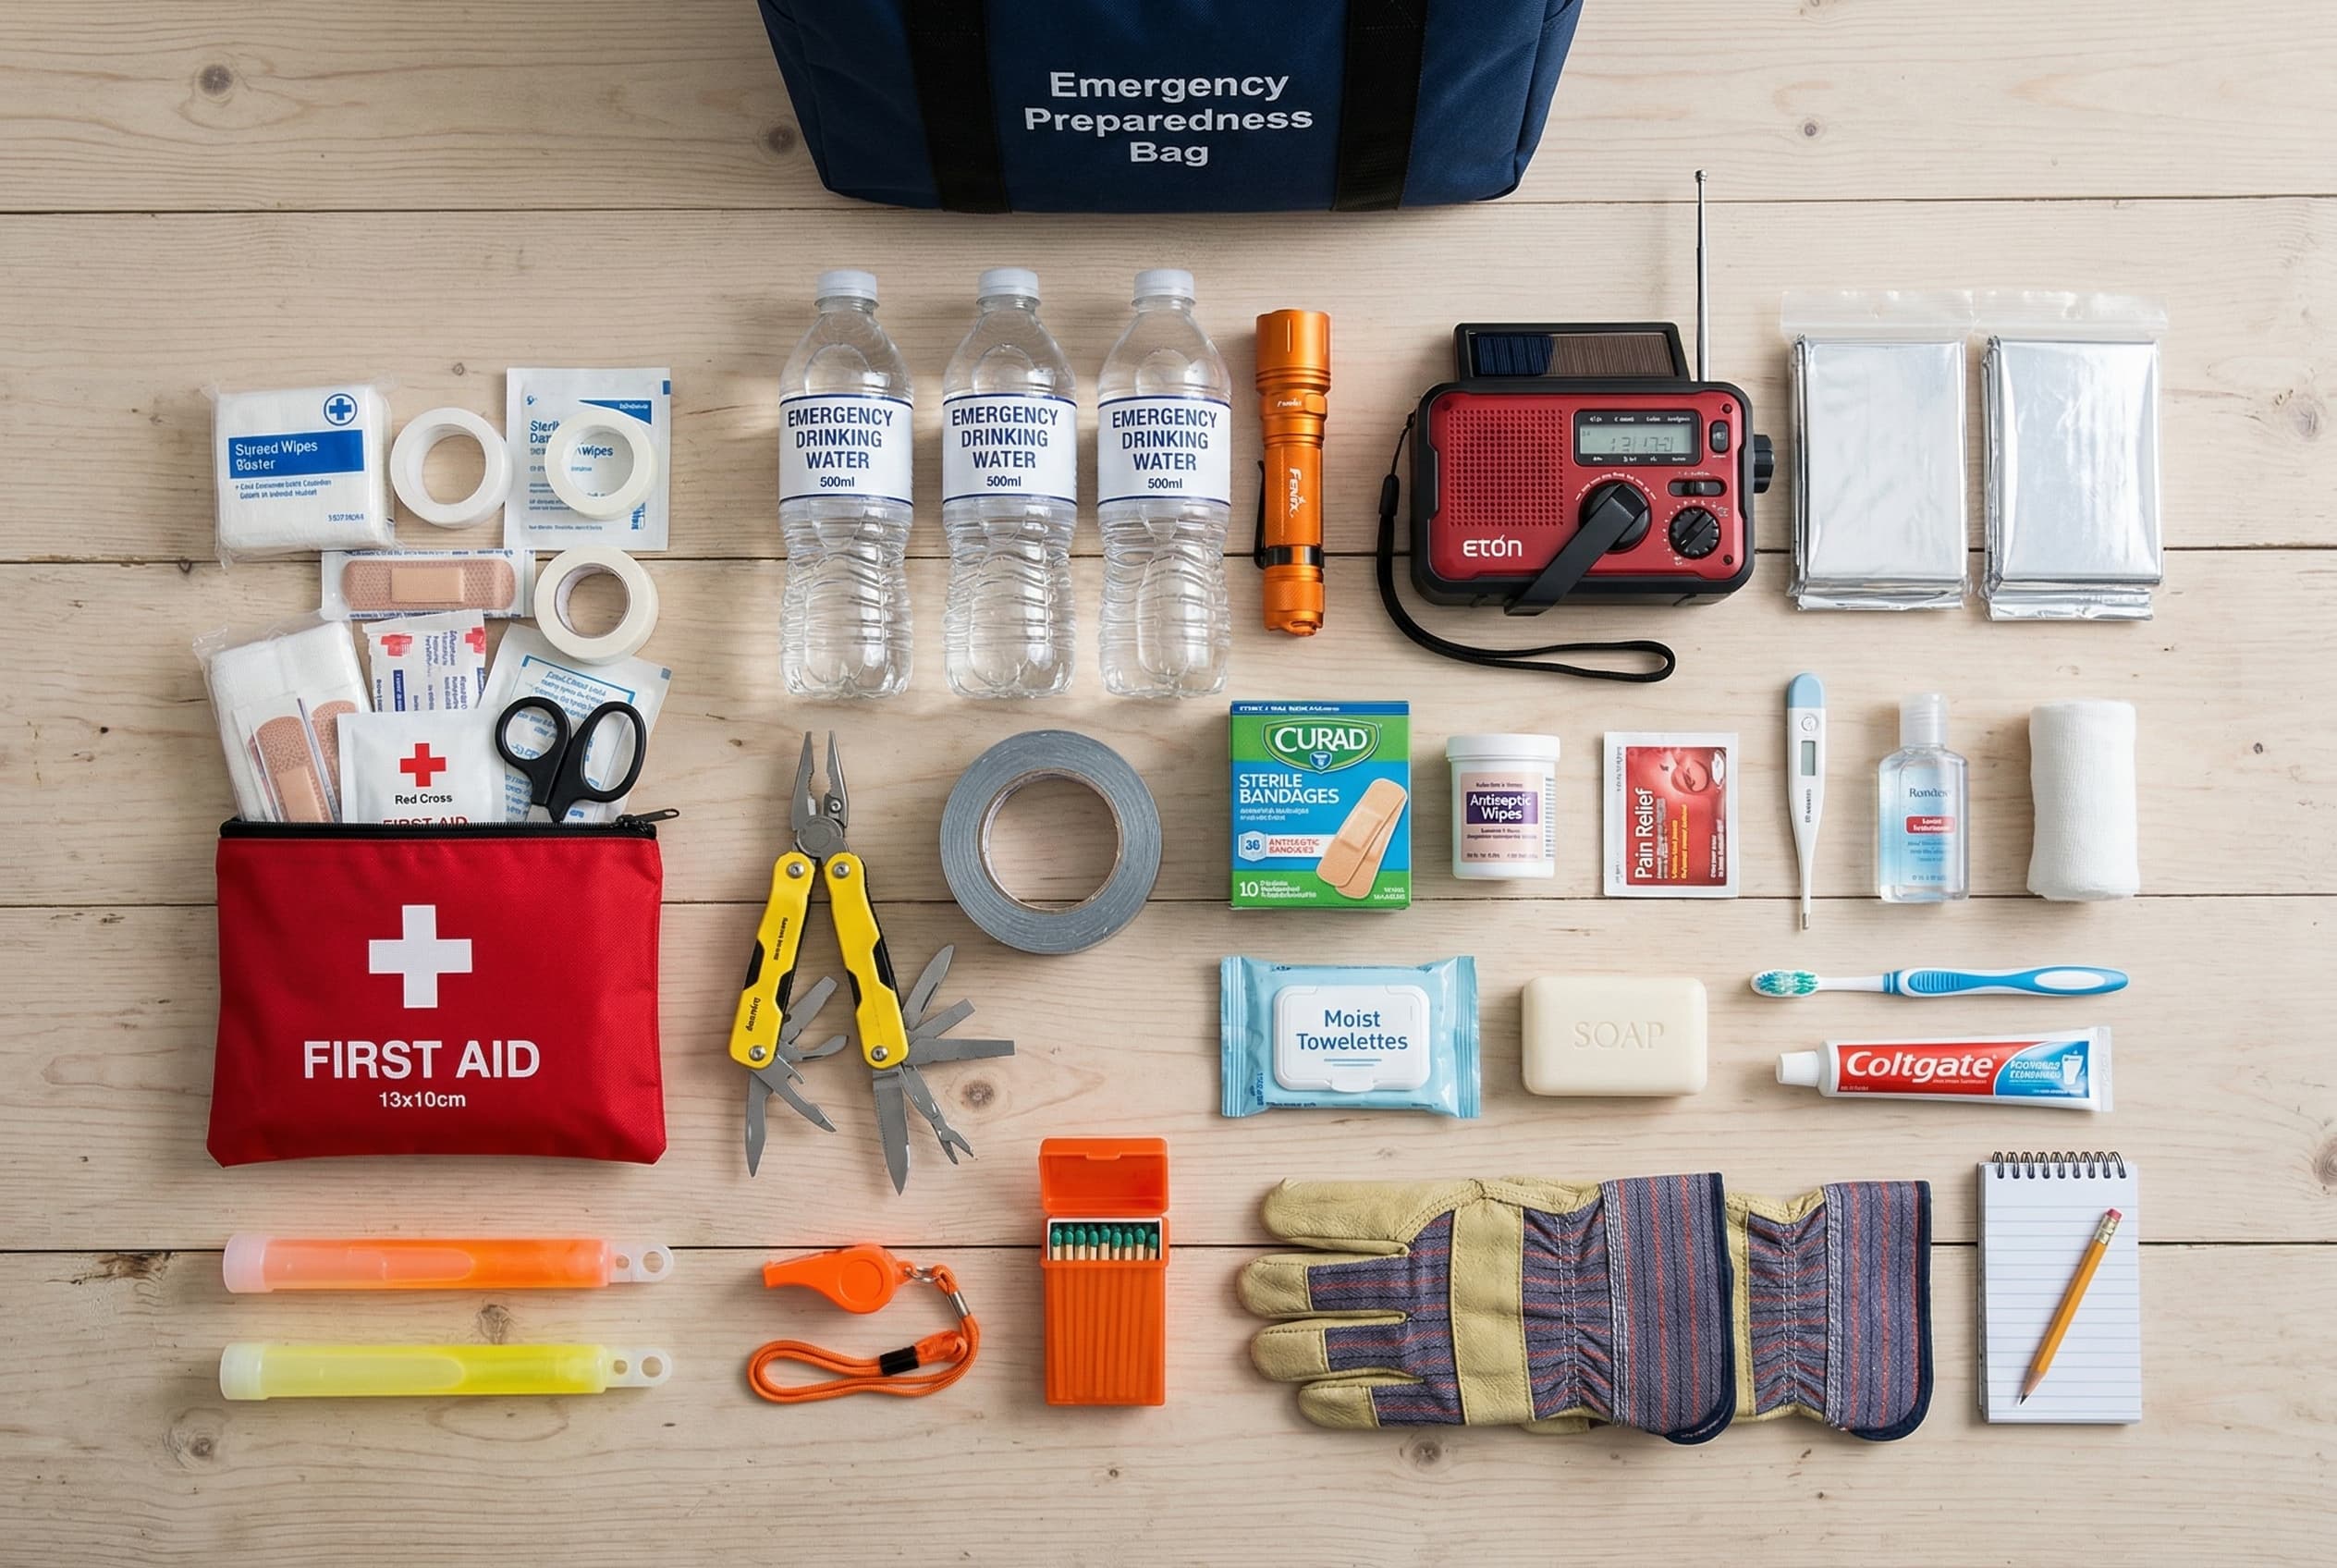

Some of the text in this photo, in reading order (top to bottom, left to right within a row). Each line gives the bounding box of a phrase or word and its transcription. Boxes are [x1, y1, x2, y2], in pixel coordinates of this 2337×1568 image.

[1050, 71, 1290, 104] Emergency
[1024, 107, 1314, 137] Preparedness
[1130, 141, 1209, 166] Bag
[788, 406, 894, 427] EMERGENCY
[952, 406, 1058, 426] EMERGENCY
[1112, 408, 1217, 429] EMERGENCY
[796, 428, 883, 448] DRINKING
[961, 428, 1048, 448] DRINKING
[1122, 430, 1208, 450] DRINKING
[281, 440, 318, 456] Wipes
[581, 445, 614, 459] Wipes
[806, 451, 870, 469] WATER
[973, 450, 1036, 469] WATER
[1132, 453, 1196, 471] WATER
[820, 476, 855, 488] 500ml
[986, 475, 1022, 487] 500ml
[1147, 478, 1183, 489] 500ml
[1275, 727, 1368, 753] CURAD
[1239, 774, 1303, 788] STERILE
[395, 793, 453, 804] Red Cross
[1240, 789, 1340, 804] BANDAGES
[1470, 794, 1531, 809] Antiseptic
[1481, 806, 1523, 823] Wipes
[1634, 788, 1653, 878] Pain Relief
[1240, 881, 1259, 898] 10
[1324, 1010, 1380, 1028] Moist
[1296, 1033, 1408, 1050] Towelettes
[1573, 1021, 1665, 1049] SOAP
[304, 1040, 541, 1079] FIRST AID
[1846, 1051, 1994, 1084] Coltgate
[379, 1091, 466, 1108] 13x10cm
